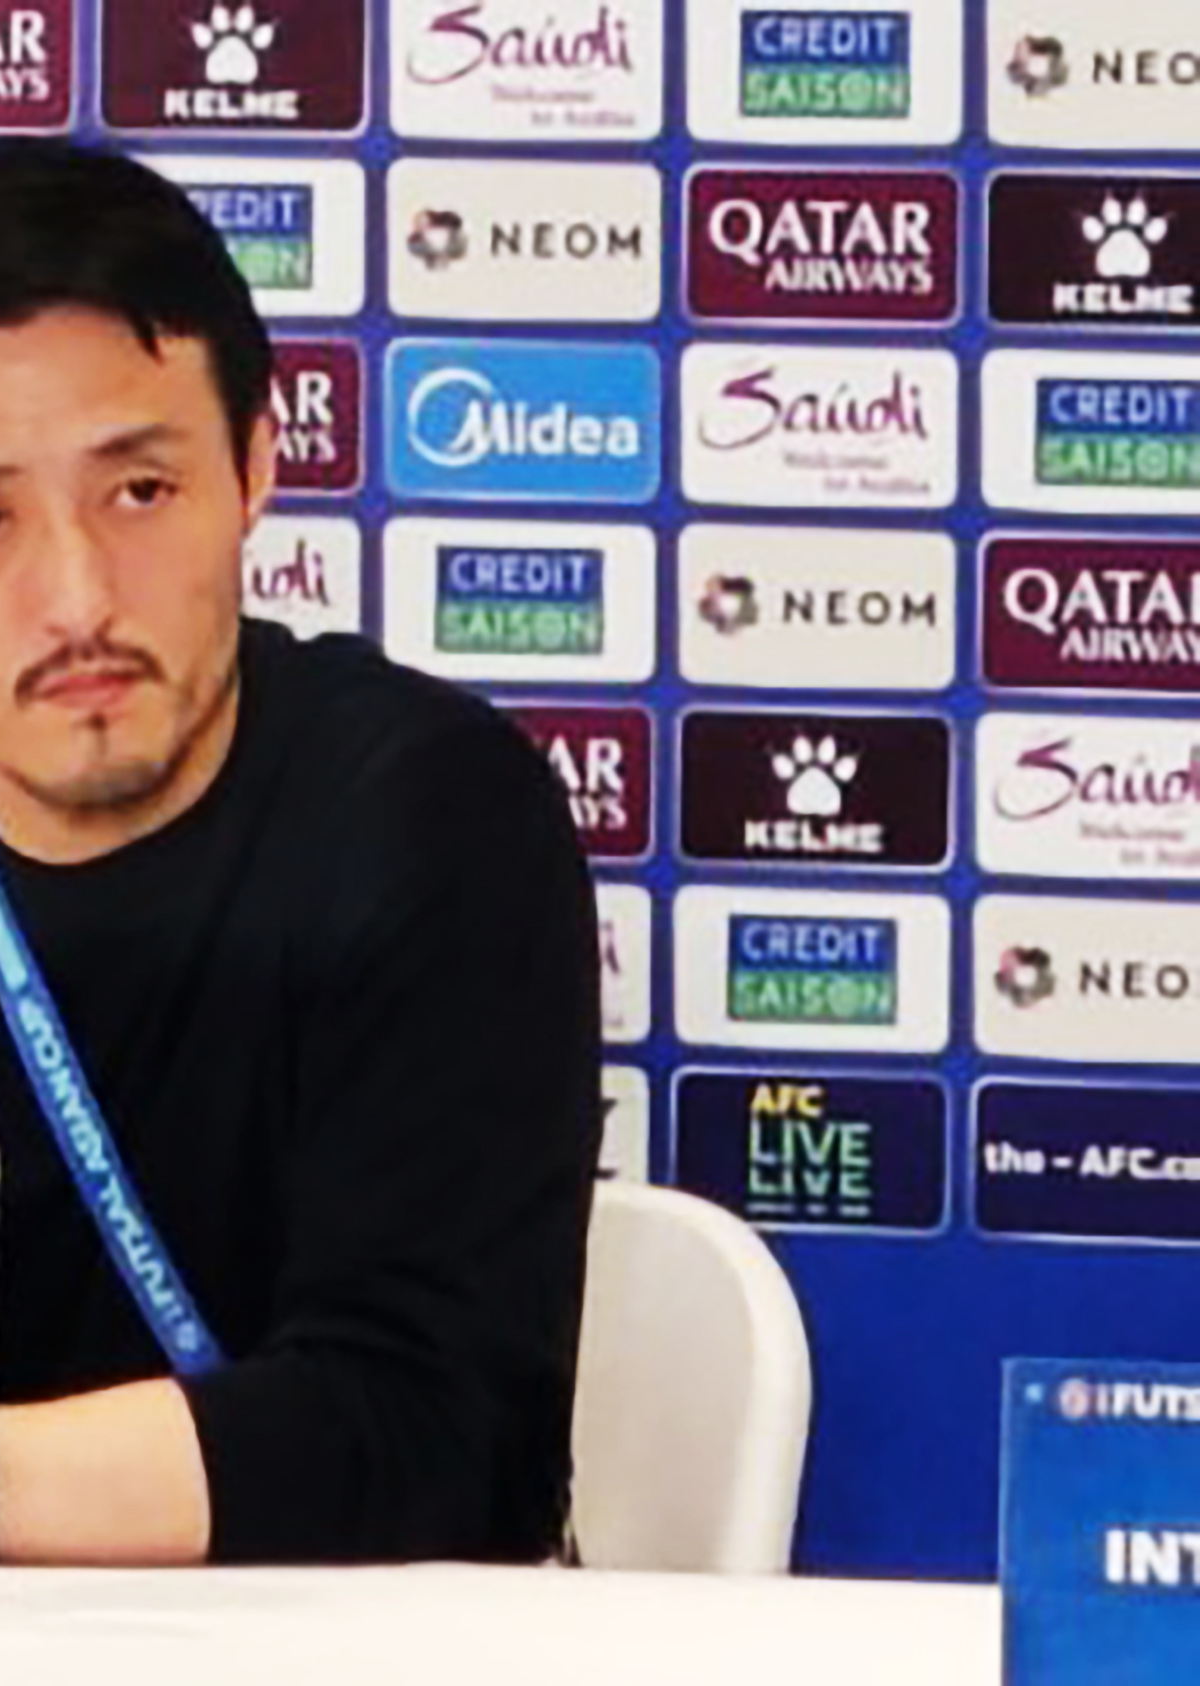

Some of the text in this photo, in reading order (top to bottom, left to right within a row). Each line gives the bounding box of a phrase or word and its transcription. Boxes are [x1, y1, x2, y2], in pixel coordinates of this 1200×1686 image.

[754, 17, 894, 56] CREDIT
[164, 89, 298, 119] KELME
[745, 71, 907, 112] SAISON
[490, 223, 642, 259] NEOM
[708, 199, 932, 266] QATAR
[765, 259, 934, 294] AIRWAYS
[1052, 283, 1195, 313] KELME
[1050, 384, 1193, 424] CREDIT
[449, 399, 640, 459] Midea
[450, 553, 585, 593] CREDIT
[781, 590, 936, 627] NEOM
[744, 820, 884, 853] KELME
[742, 923, 883, 963] CREDIT
[751, 1085, 825, 1117] AFC
[750, 1121, 871, 1167] LIVE
[984, 1142, 1043, 1175] the
